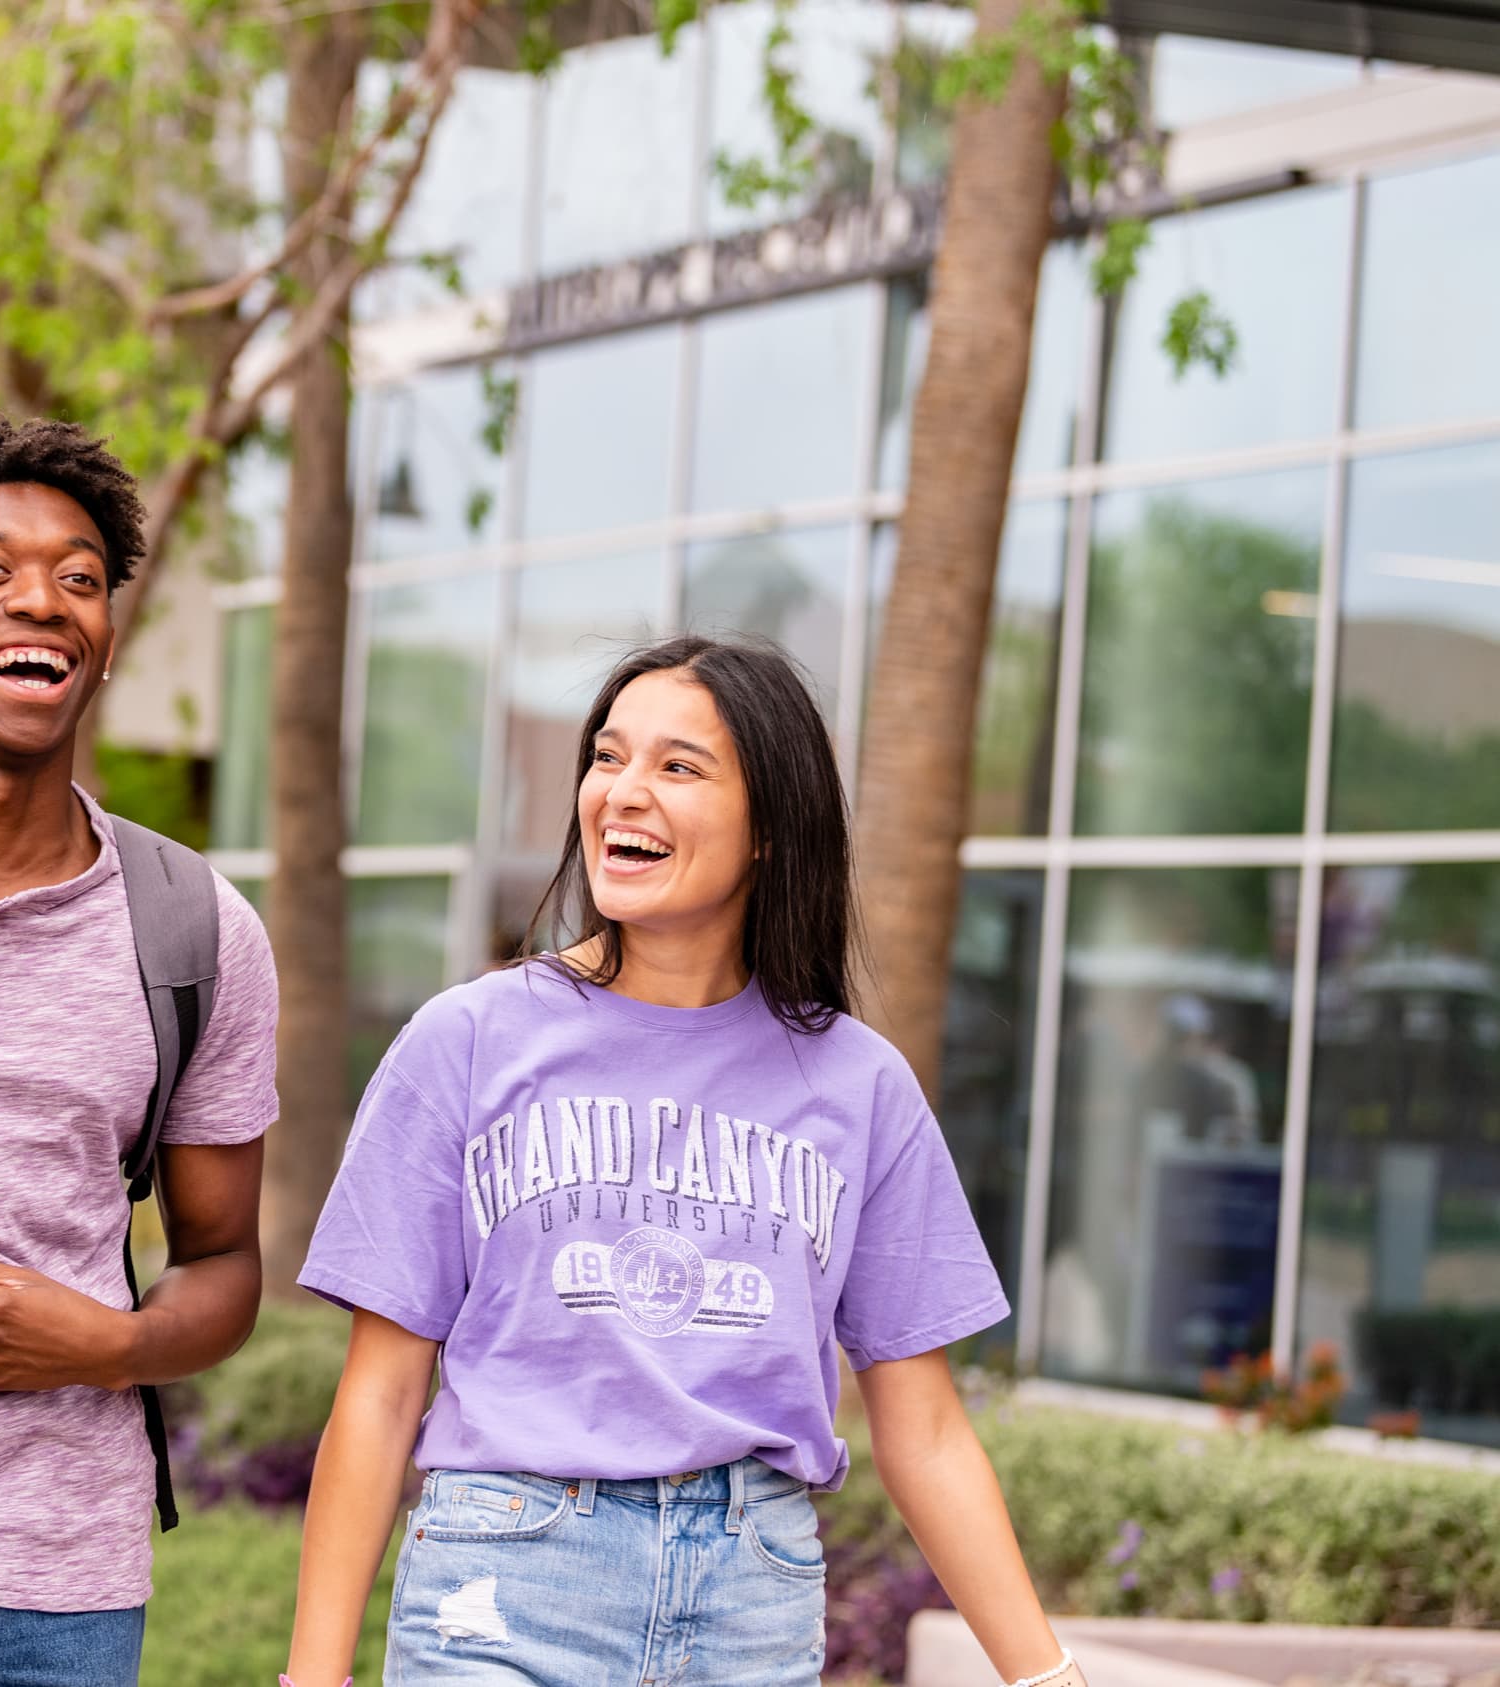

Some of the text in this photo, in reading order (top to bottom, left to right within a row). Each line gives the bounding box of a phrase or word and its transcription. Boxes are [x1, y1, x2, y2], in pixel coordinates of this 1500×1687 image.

[465, 1096, 847, 1276] GRAND CANYON
[539, 1189, 783, 1255] UNIVERSITY
[568, 1251, 761, 1306] 19 49
